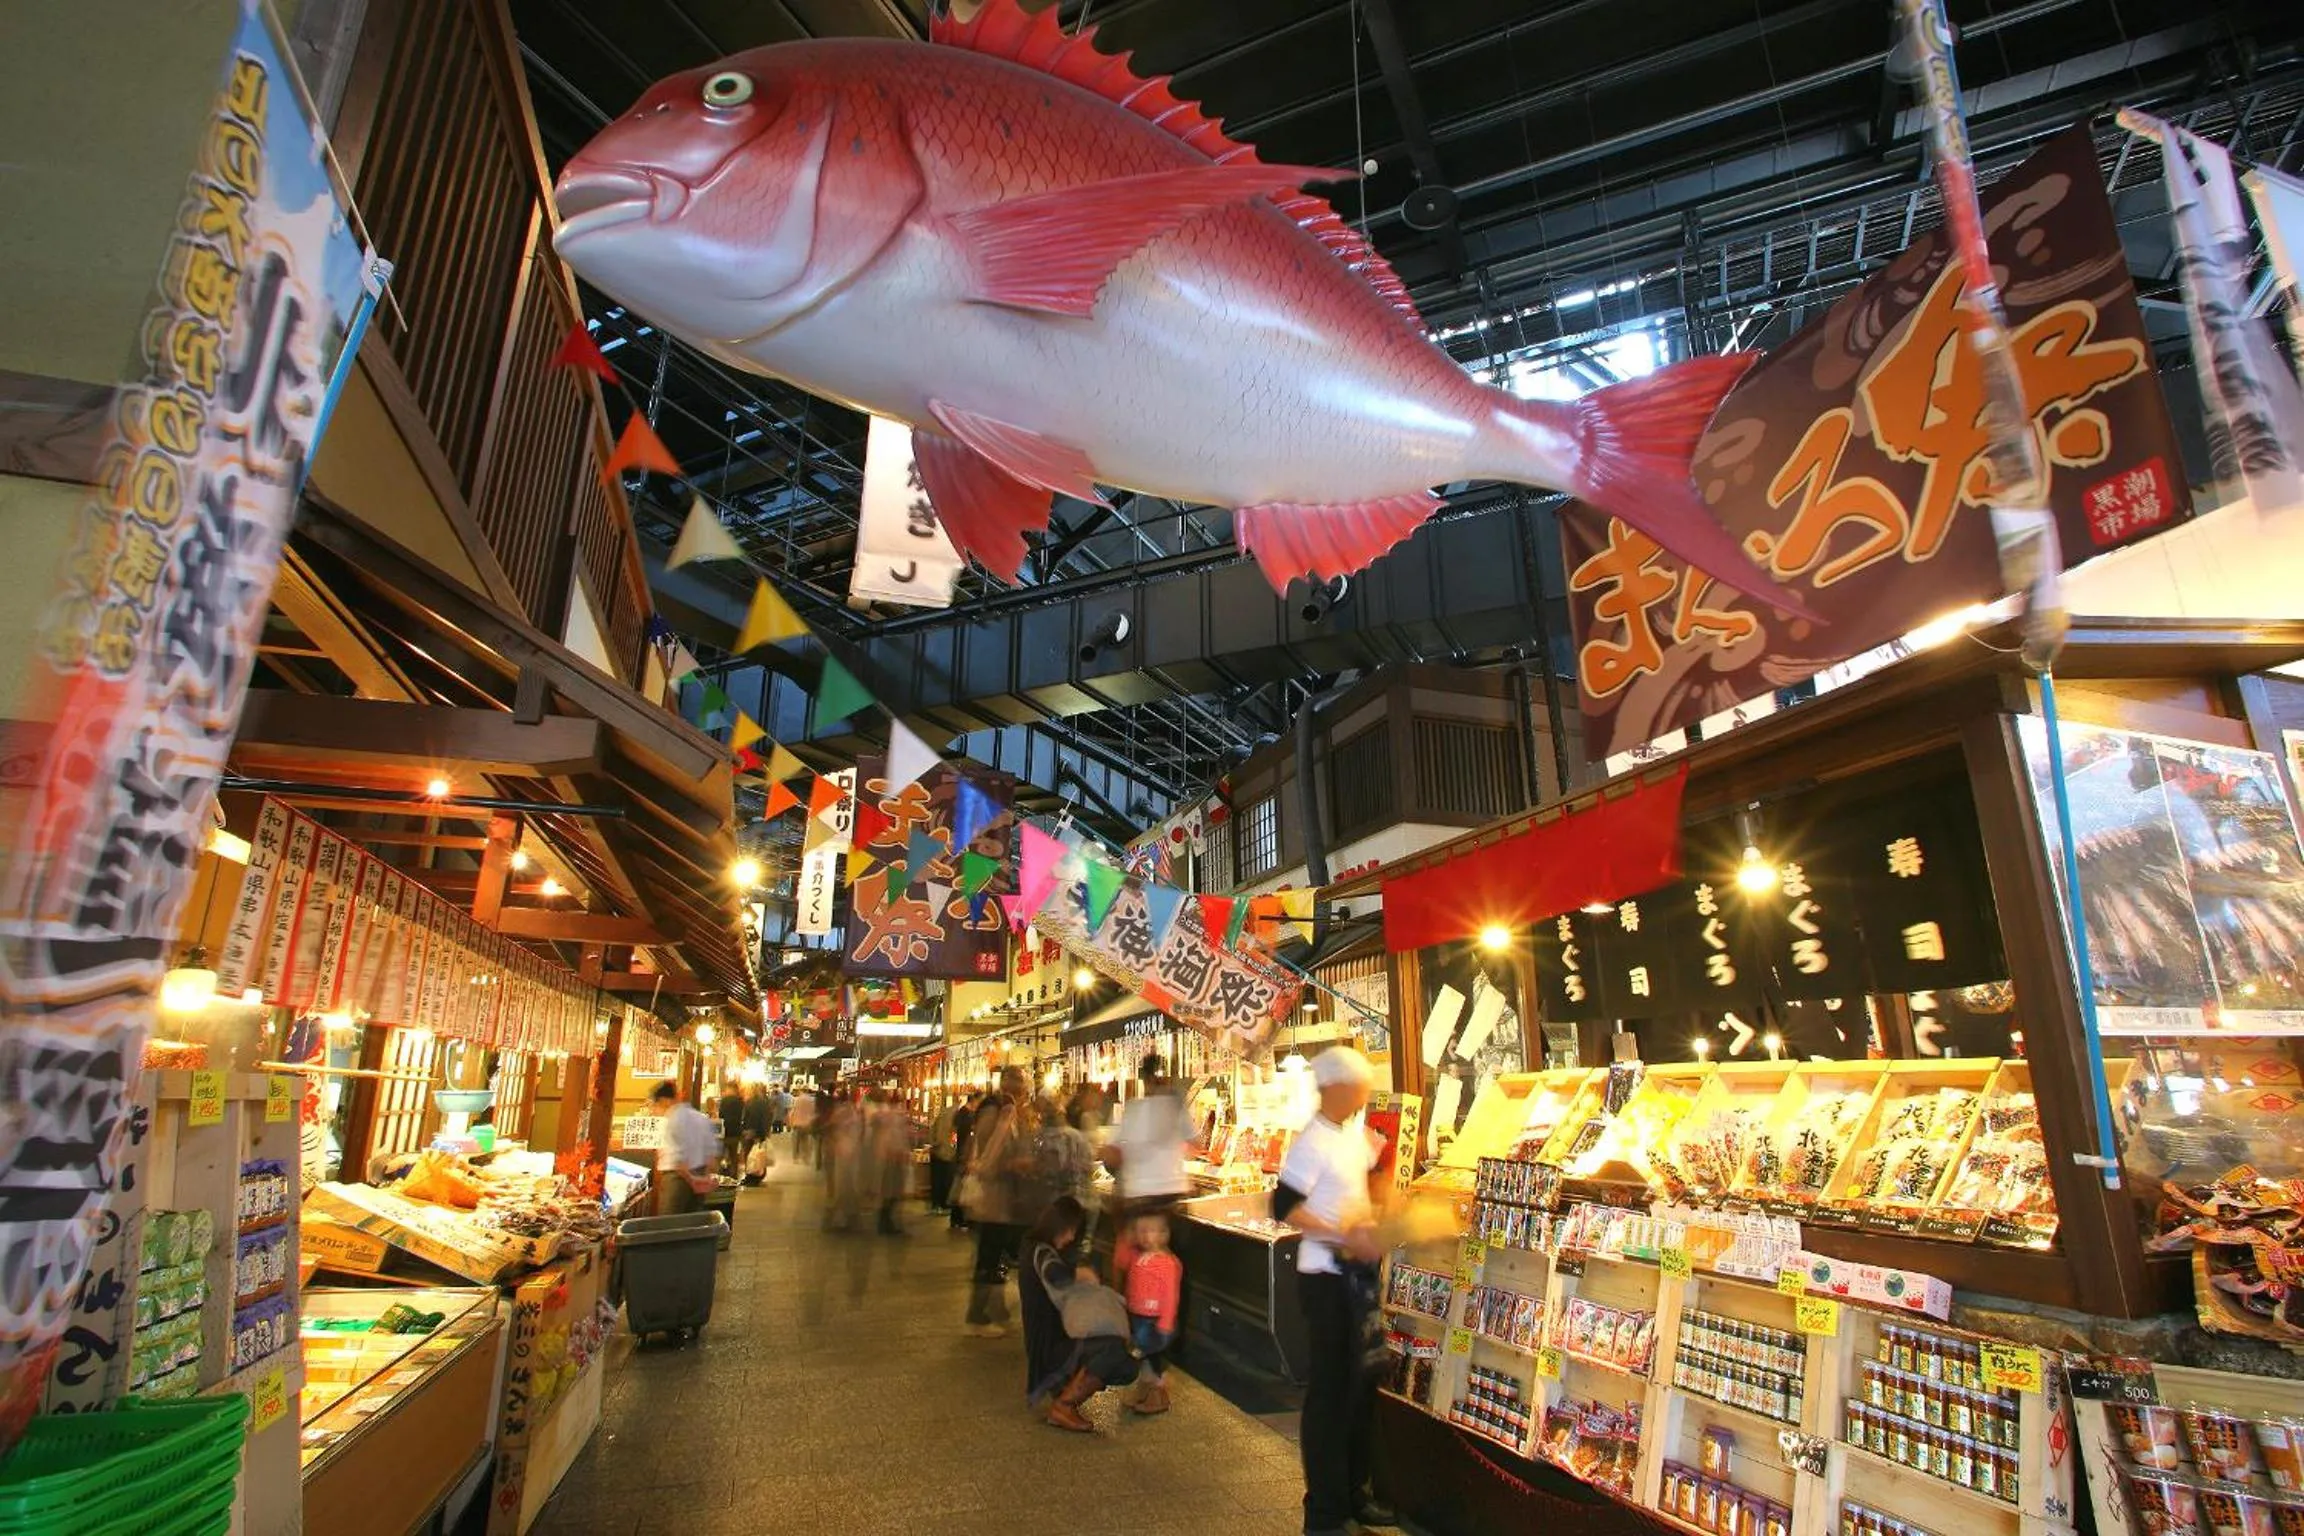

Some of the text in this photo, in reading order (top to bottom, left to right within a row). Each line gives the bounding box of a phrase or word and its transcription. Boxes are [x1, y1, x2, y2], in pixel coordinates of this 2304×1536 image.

[1694, 883, 1737, 987] まぐろ
[1781, 862, 1830, 975] まぐろ
[1886, 837, 1946, 961] 寿司
[1556, 914, 1587, 1003] まぐろ
[1618, 901, 1650, 998] 寿司
[2124, 1386, 2150, 1400] 500
